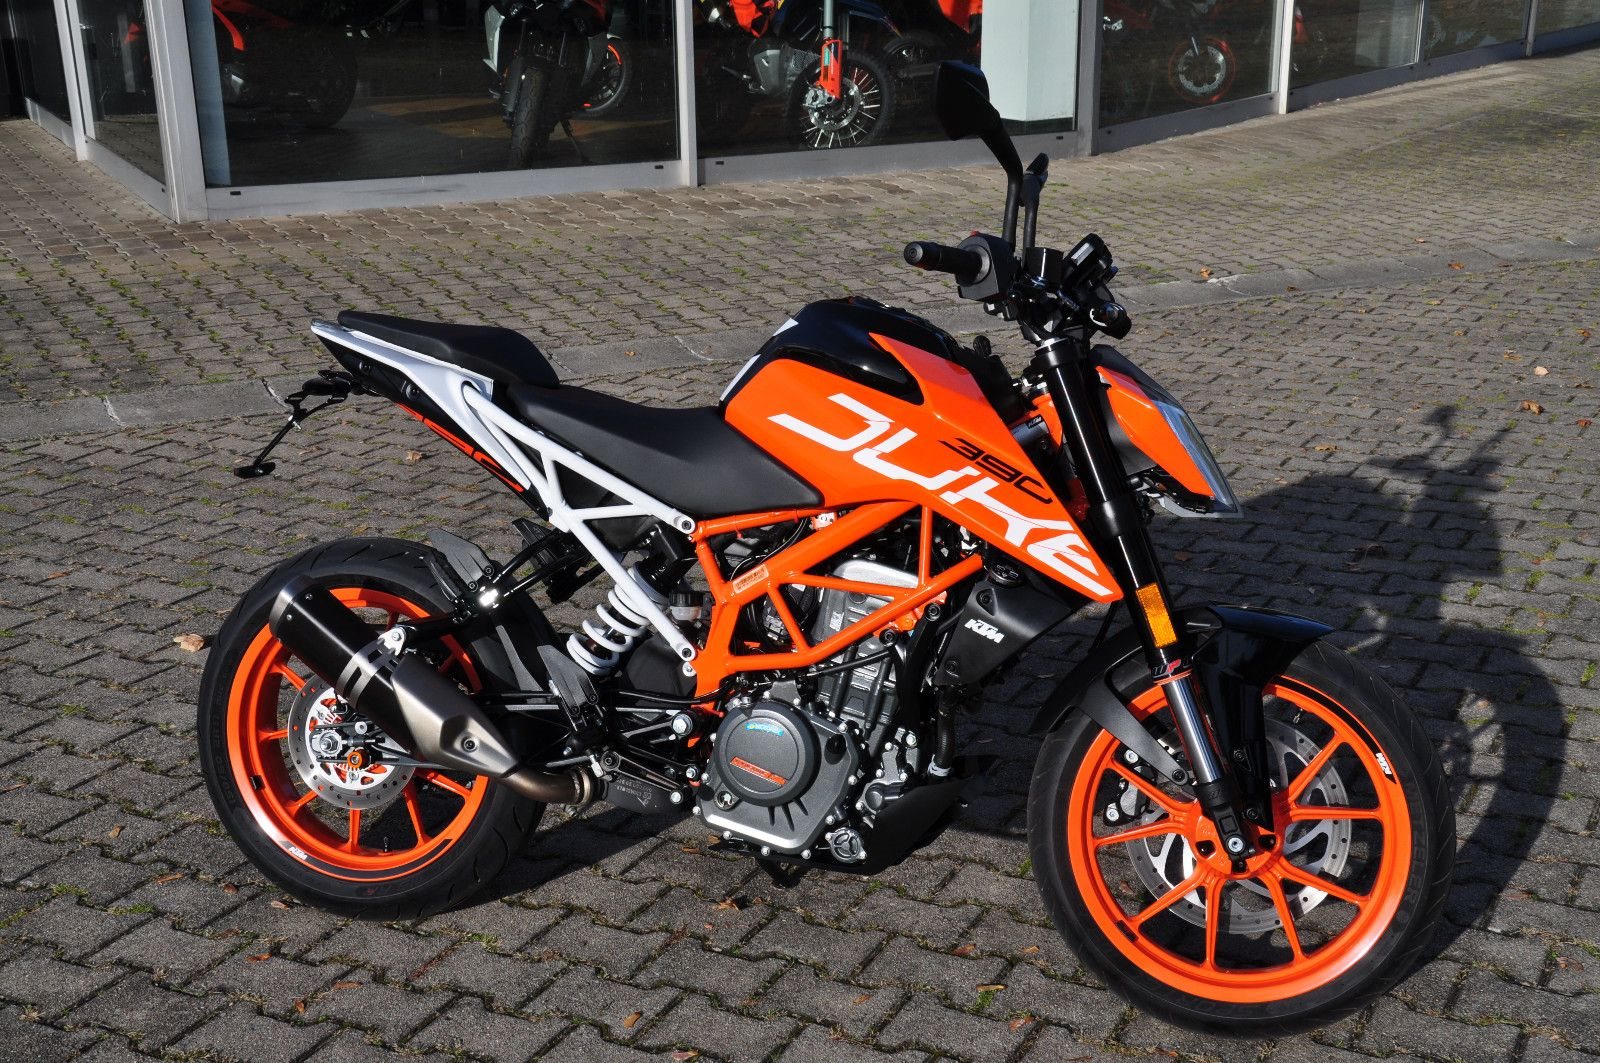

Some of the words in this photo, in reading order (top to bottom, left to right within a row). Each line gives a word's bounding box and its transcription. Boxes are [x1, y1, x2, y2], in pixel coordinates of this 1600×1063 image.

[938, 438, 1053, 504] 390
[767, 393, 1113, 596] DUKE
[964, 618, 1005, 644] KTM
[1375, 752, 1393, 775] KTM
[288, 846, 308, 860] KTM
